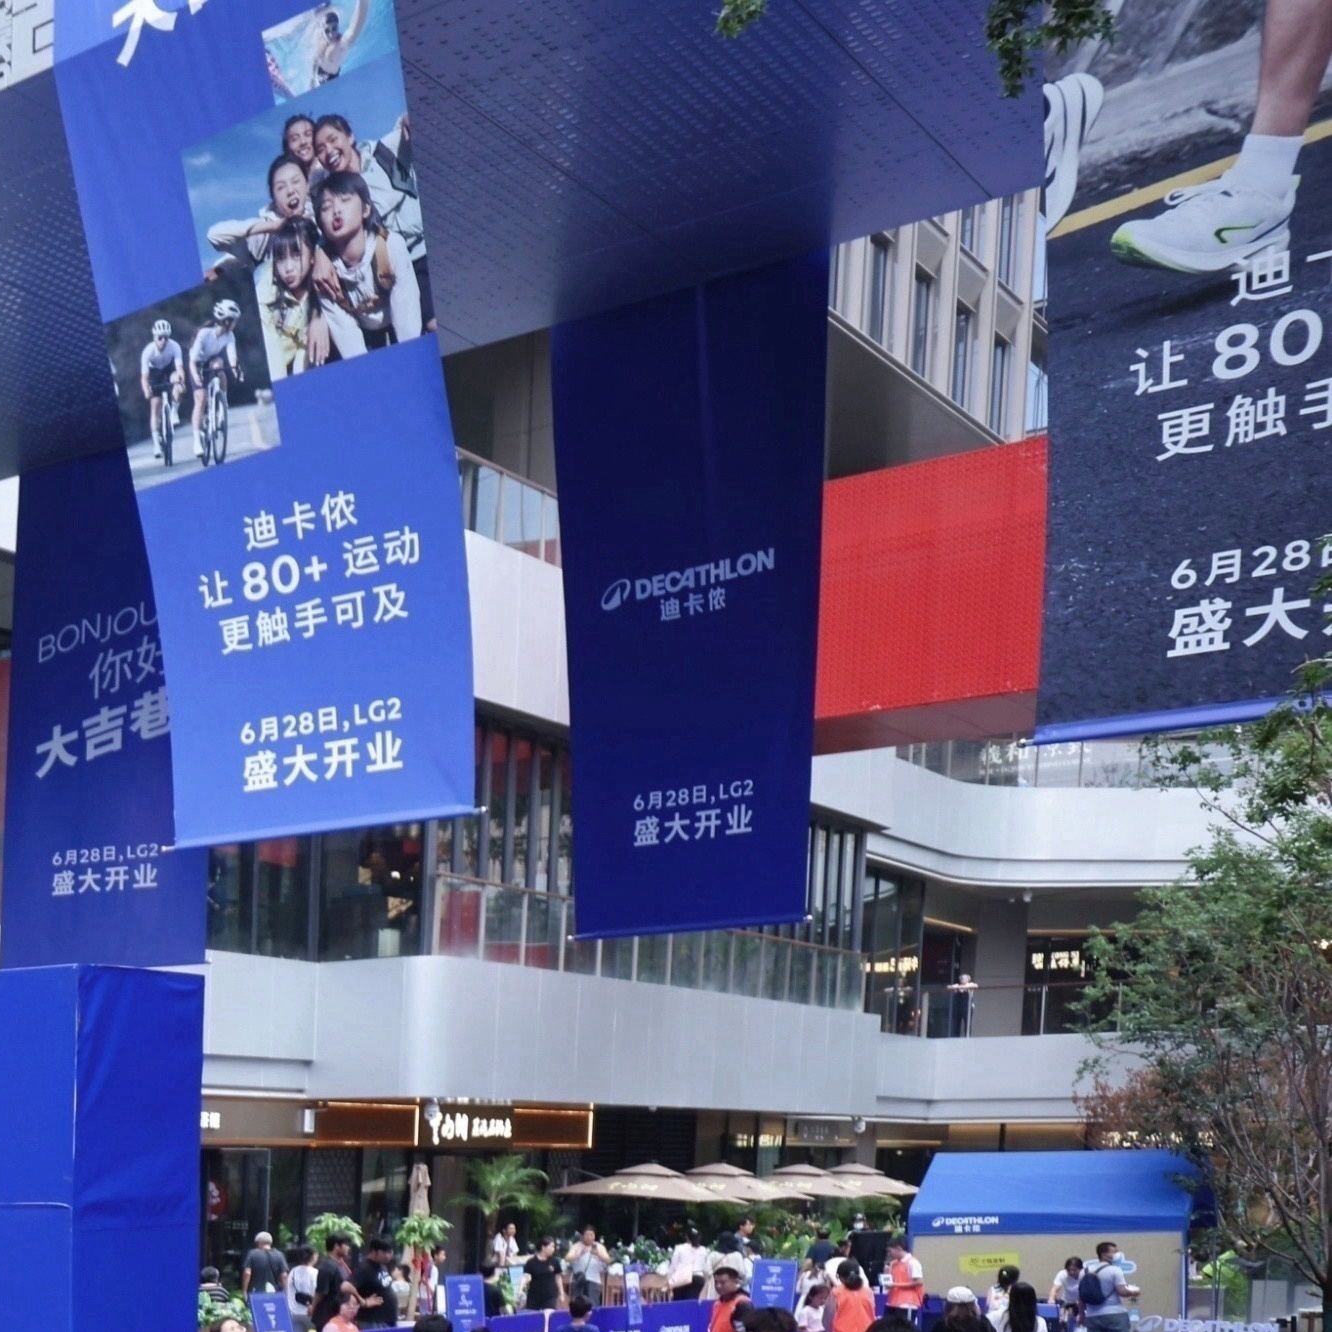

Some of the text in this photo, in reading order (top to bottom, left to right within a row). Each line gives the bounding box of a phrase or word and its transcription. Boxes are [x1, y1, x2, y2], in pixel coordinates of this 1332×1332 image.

[1129, 339, 1188, 397] 让
[244, 491, 358, 552] 迪卡侬
[198, 526, 421, 609] 让 80+ 运动
[635, 548, 775, 601] DECATHLON
[38, 601, 159, 664] BONJOU
[220, 582, 409, 655] 更触手可及
[660, 587, 727, 622] 迪卡侬
[1167, 586, 1332, 658] 盛大
[35, 684, 172, 780] 大吉巷
[243, 731, 404, 793] 盛大开业
[634, 804, 753, 847] 盛大开业
[52, 864, 158, 896] 盛大开业
[945, 1216, 999, 1226] DECATHLON
